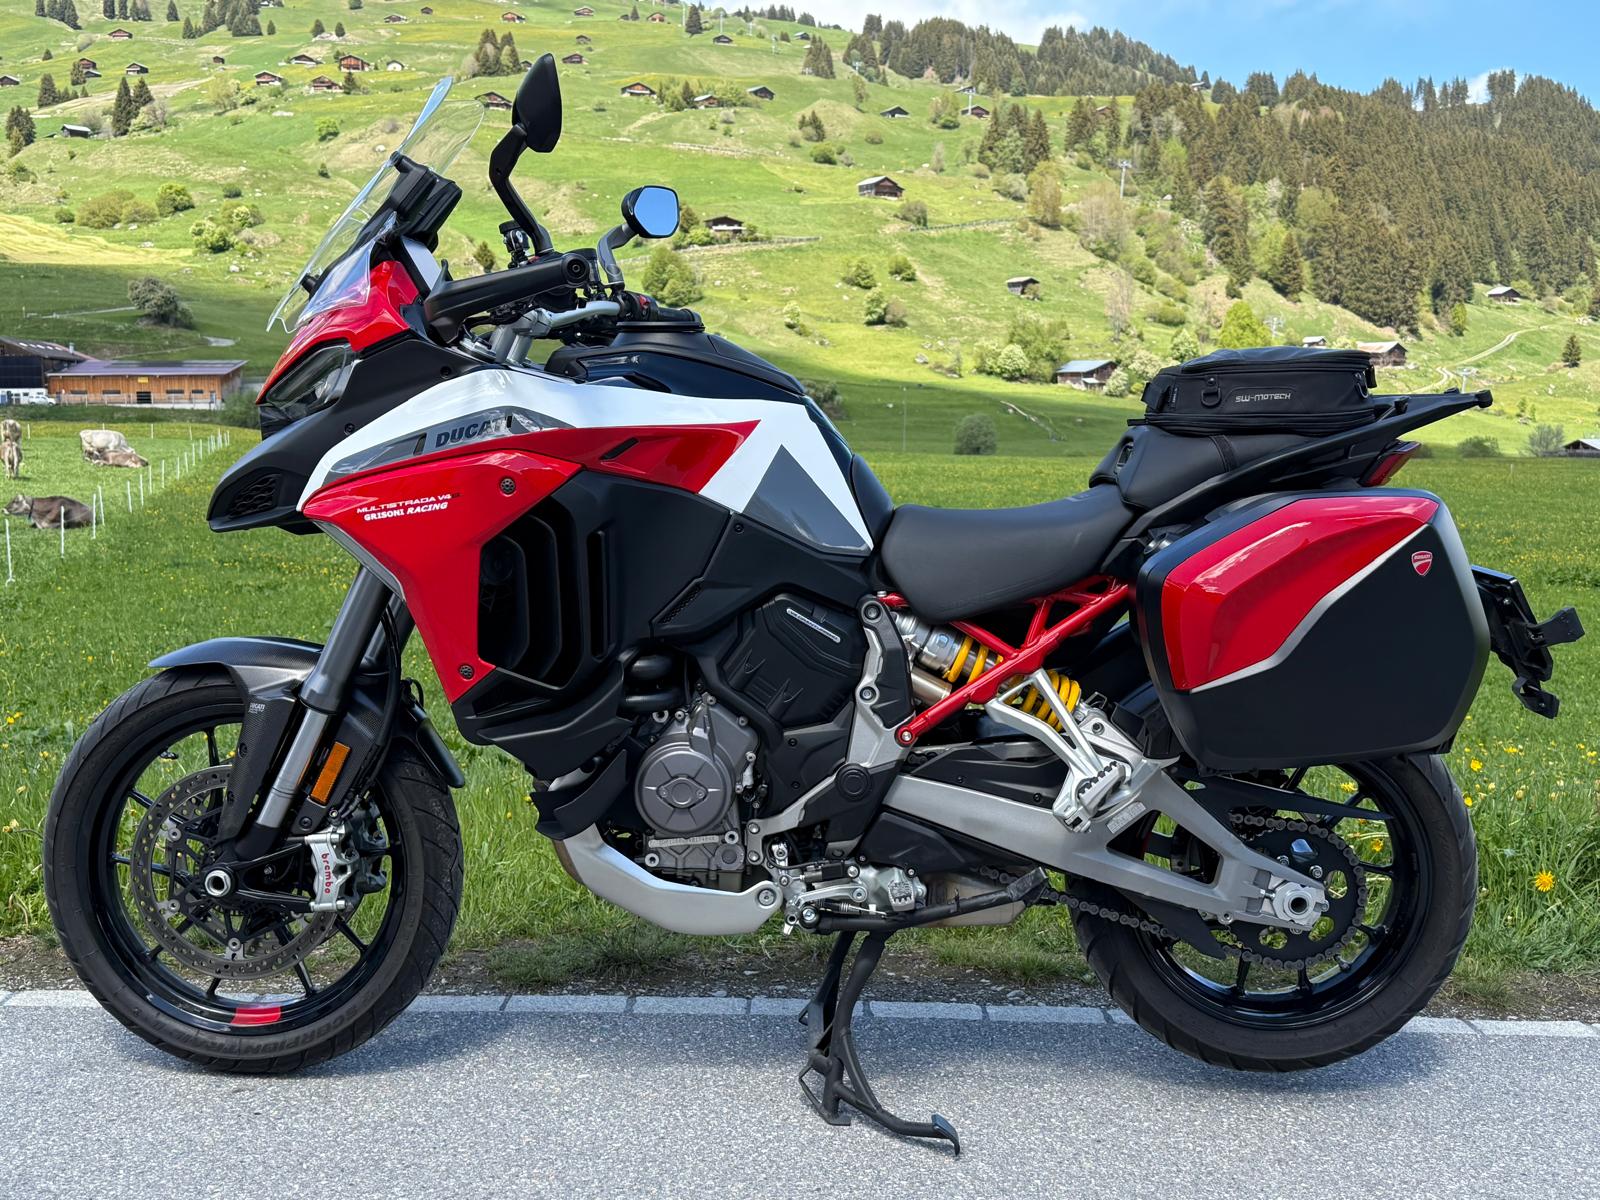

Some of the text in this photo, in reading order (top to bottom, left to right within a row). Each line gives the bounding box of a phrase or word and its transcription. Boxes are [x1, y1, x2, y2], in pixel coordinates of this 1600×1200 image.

[1235, 393, 1292, 403] SW-MOTECH
[356, 496, 437, 514] MULTISTRADA
[363, 501, 449, 521] GRISONI RACING
[321, 852, 334, 894] brembo
